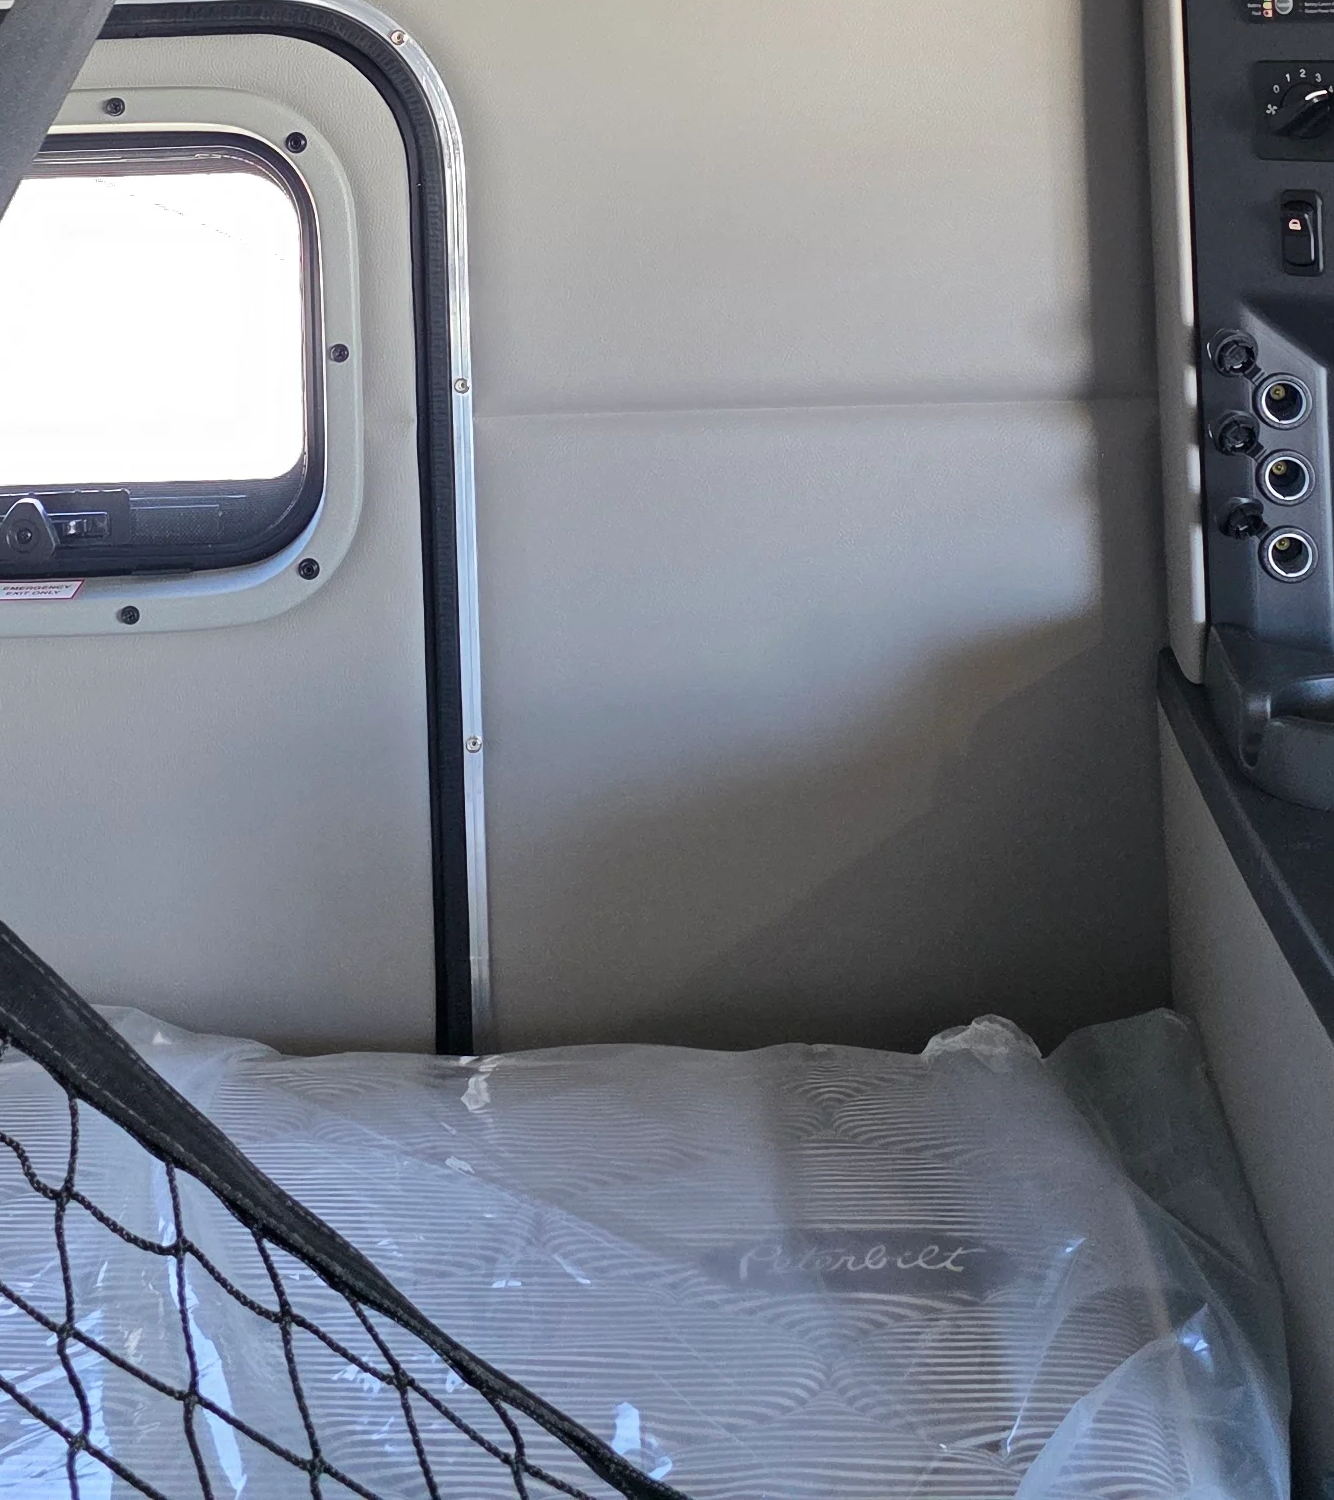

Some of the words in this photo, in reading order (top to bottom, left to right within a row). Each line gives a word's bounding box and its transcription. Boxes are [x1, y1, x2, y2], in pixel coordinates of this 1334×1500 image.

[1273, 84, 1280, 93] 0
[1285, 73, 1291, 82] 1
[1299, 68, 1307, 78] 2
[1315, 72, 1322, 82] 3
